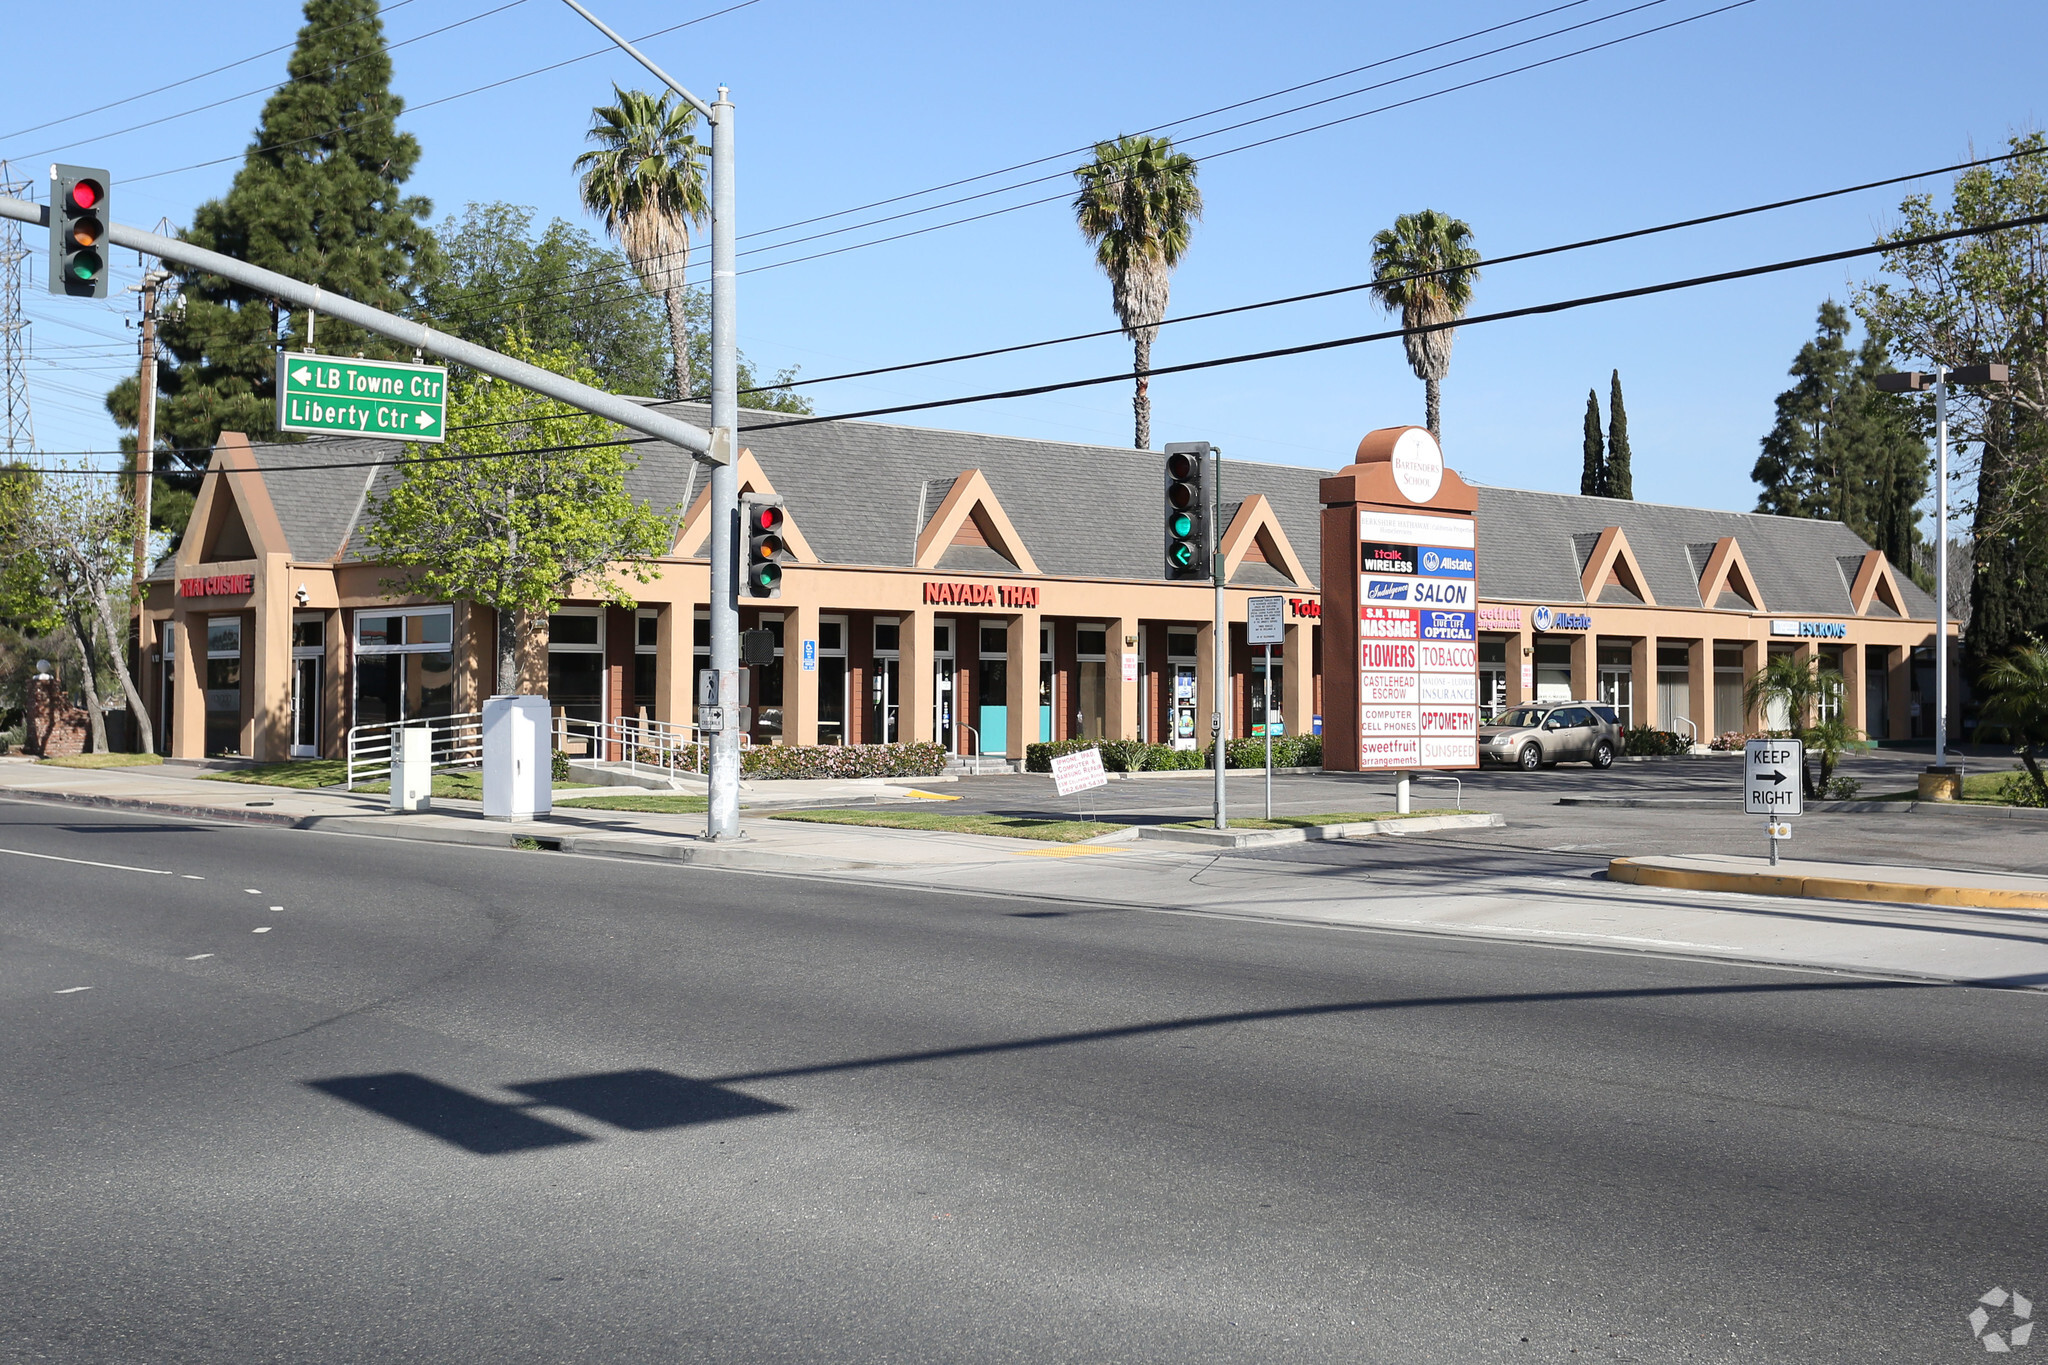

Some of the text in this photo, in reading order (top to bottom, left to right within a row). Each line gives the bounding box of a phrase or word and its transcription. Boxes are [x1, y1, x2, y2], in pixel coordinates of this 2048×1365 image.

[316, 367, 440, 398] LB Towne Ctr
[291, 399, 409, 431] Liberty Ctr
[1361, 517, 1396, 527] BERKSHIRE
[1364, 558, 1413, 573] WIRELESS
[1440, 557, 1473, 571] Allstate
[180, 574, 253, 597] THAI CUISINE
[1369, 583, 1408, 600] Indulgence
[925, 582, 1040, 606] NAYADA THAI
[1414, 583, 1467, 604] SALON
[1366, 608, 1410, 619] S.N. THAI
[1554, 612, 1592, 629] Allstate
[1361, 619, 1417, 638] MASSAGE
[1432, 619, 1464, 629] LIVE LIFE
[1800, 621, 1847, 637] ESCROWS
[1424, 626, 1472, 640] OPTICAL
[1362, 644, 1415, 668] FLOWERS
[1422, 646, 1476, 668] TOBACCO
[1363, 675, 1415, 687] CASTLEHEAD
[1372, 688, 1407, 699] ESCROW
[1422, 688, 1474, 700] INSURANCE
[1365, 710, 1412, 719] COMPUTER
[1421, 712, 1474, 730] OPTOMETRY
[1362, 722, 1417, 731] CELL PHONES
[1362, 740, 1417, 753] sweetfruit
[1425, 743, 1474, 758] SUNSPEED
[1361, 756, 1418, 767] arrangements
[1753, 750, 1791, 764] KEEP
[1058, 761, 1089, 773] COMPUTER
[1752, 790, 1793, 805] RIGHT
